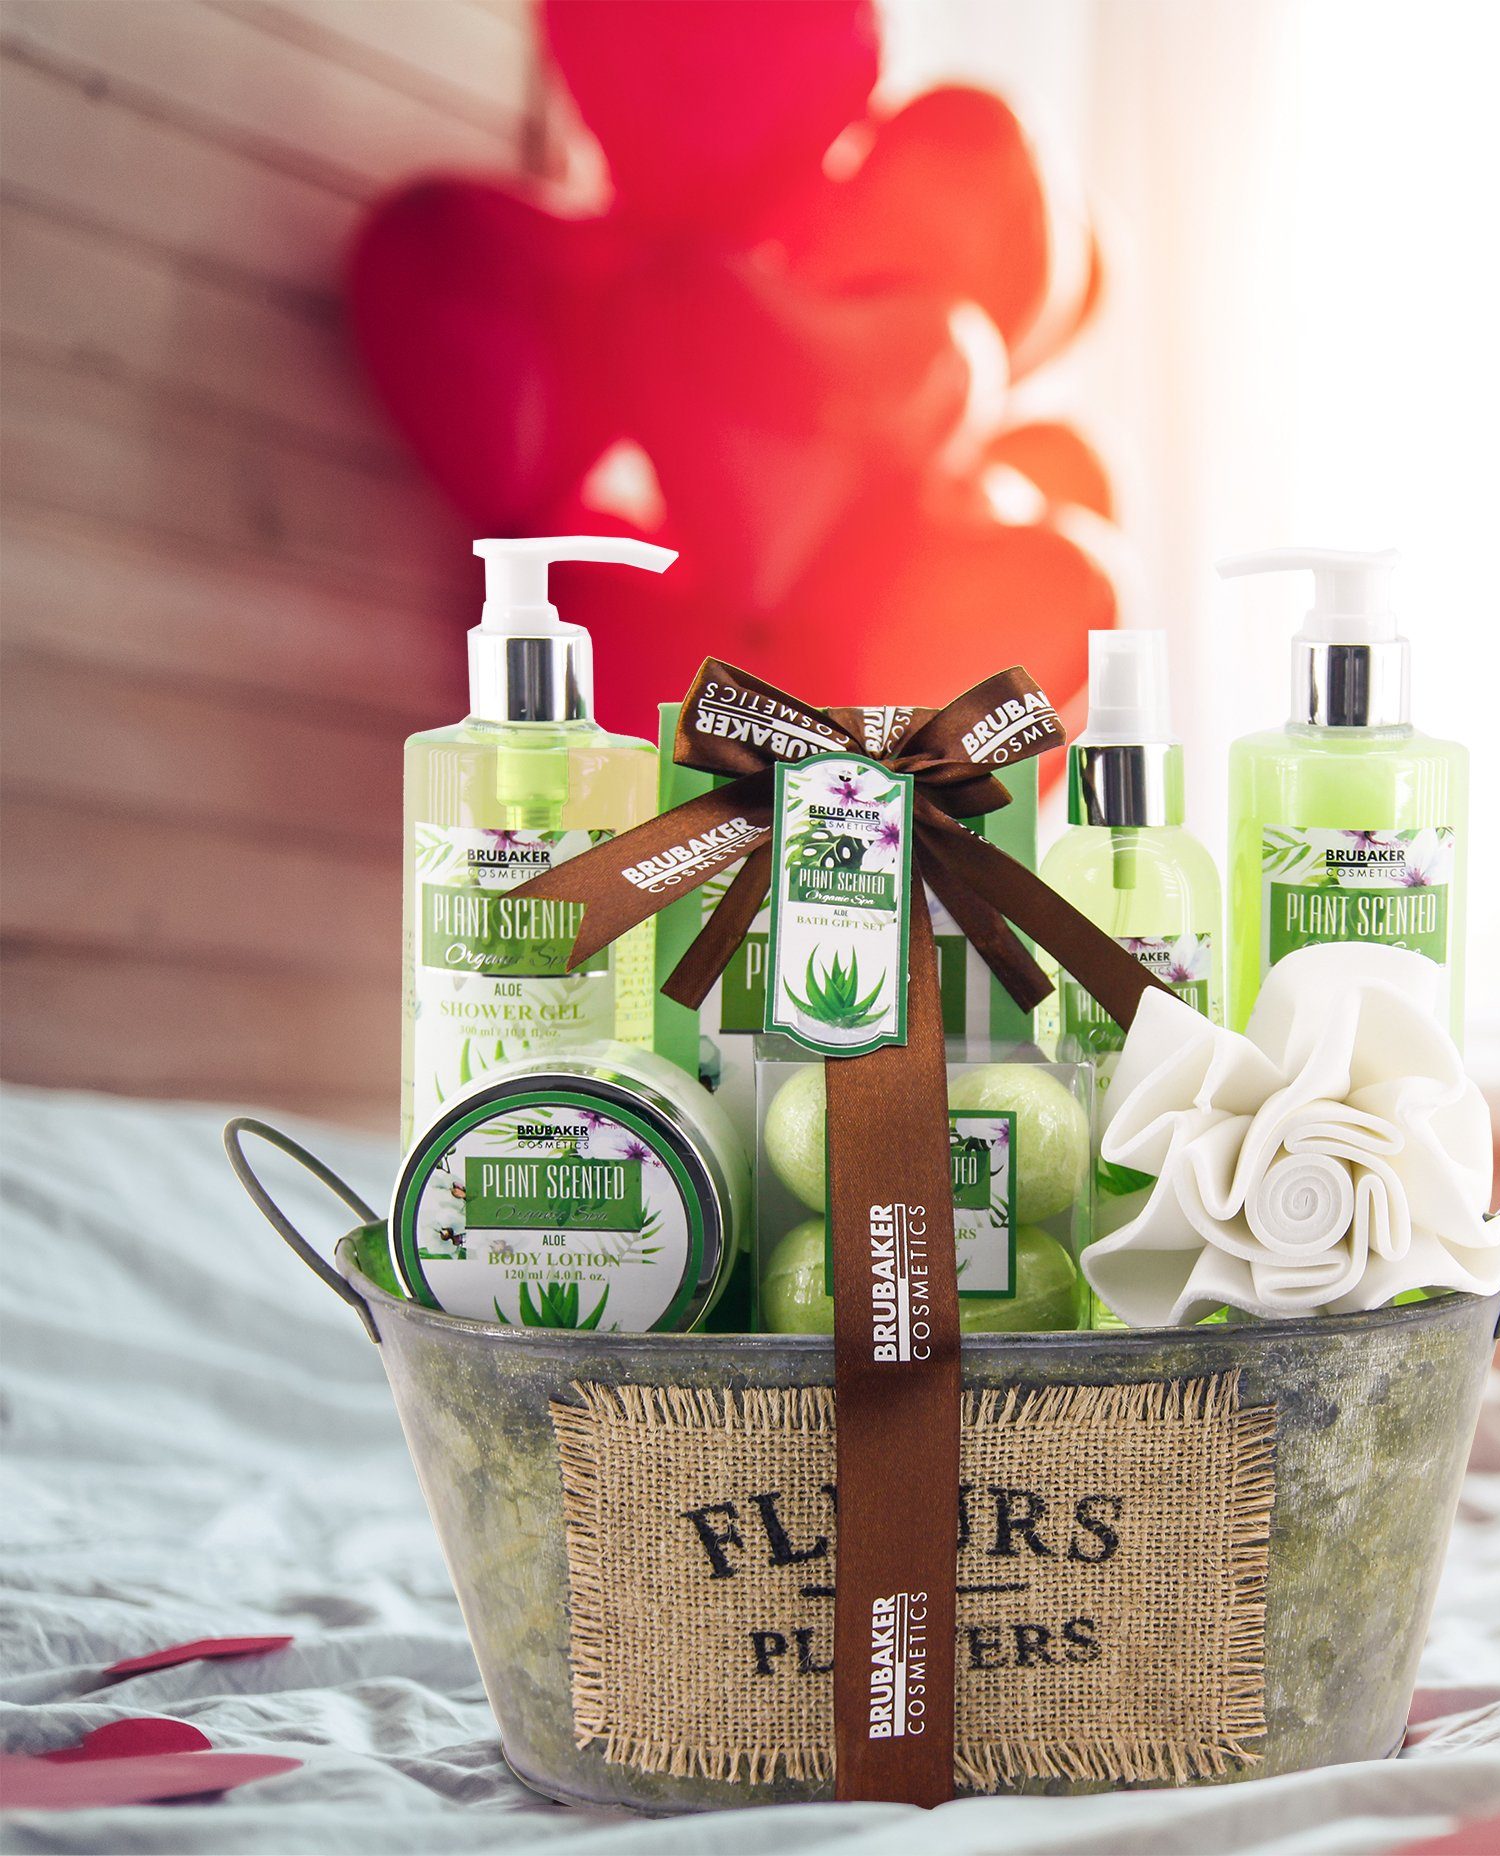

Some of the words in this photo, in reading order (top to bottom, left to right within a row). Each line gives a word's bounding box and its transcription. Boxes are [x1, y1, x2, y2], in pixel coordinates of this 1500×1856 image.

[981, 717, 1059, 763] OSME
[809, 804, 880, 820] BRUBAKER
[809, 819, 880, 833] COSMETICS
[467, 849, 551, 863] BRUBAKER
[621, 817, 756, 885] BRUBAKER
[1326, 850, 1405, 861] BRUBAKER
[467, 867, 541, 879] COSMETIC
[1326, 868, 1406, 878] COSMETICS
[799, 868, 834, 889] PLANT
[837, 871, 885, 895] SCENTED
[805, 889, 850, 903] Organic
[851, 894, 875, 906] Spa
[433, 893, 492, 939] PLANT
[500, 897, 585, 940] SCENTE
[833, 909, 848, 917] ALOE
[1286, 893, 1349, 935] PLANT
[1357, 894, 1437, 936] SCENTED
[796, 915, 828, 926] BATH
[831, 918, 859, 929] GIFT
[863, 921, 886, 931] SET
[1131, 952, 1170, 961] BAKER
[494, 983, 522, 997] ALOE
[440, 1001, 533, 1020] SHOWER
[540, 1003, 585, 1020] GEL
[517, 1125, 589, 1136] BRUBAKER
[517, 1140, 589, 1150] COSMETICS
[482, 1164, 538, 1198] PLANT
[546, 1165, 625, 1200] SCENTED
[542, 1234, 566, 1246] ALOE
[488, 1252, 541, 1265] BODY
[547, 1253, 620, 1267] LOTION
[505, 1269, 524, 1279] 120
[528, 1269, 543, 1279] ml
[553, 1270, 571, 1280] 4.0
[574, 1270, 586, 1280] fl.
[589, 1272, 606, 1281] oz.
[870, 1204, 897, 1362] BRUBAKER
[909, 1205, 931, 1360] COSMETICS
[749, 1617, 1100, 1675] PLERS
[869, 1594, 896, 1739] BRUBAKER
[908, 1591, 927, 1735] COSMETICS
